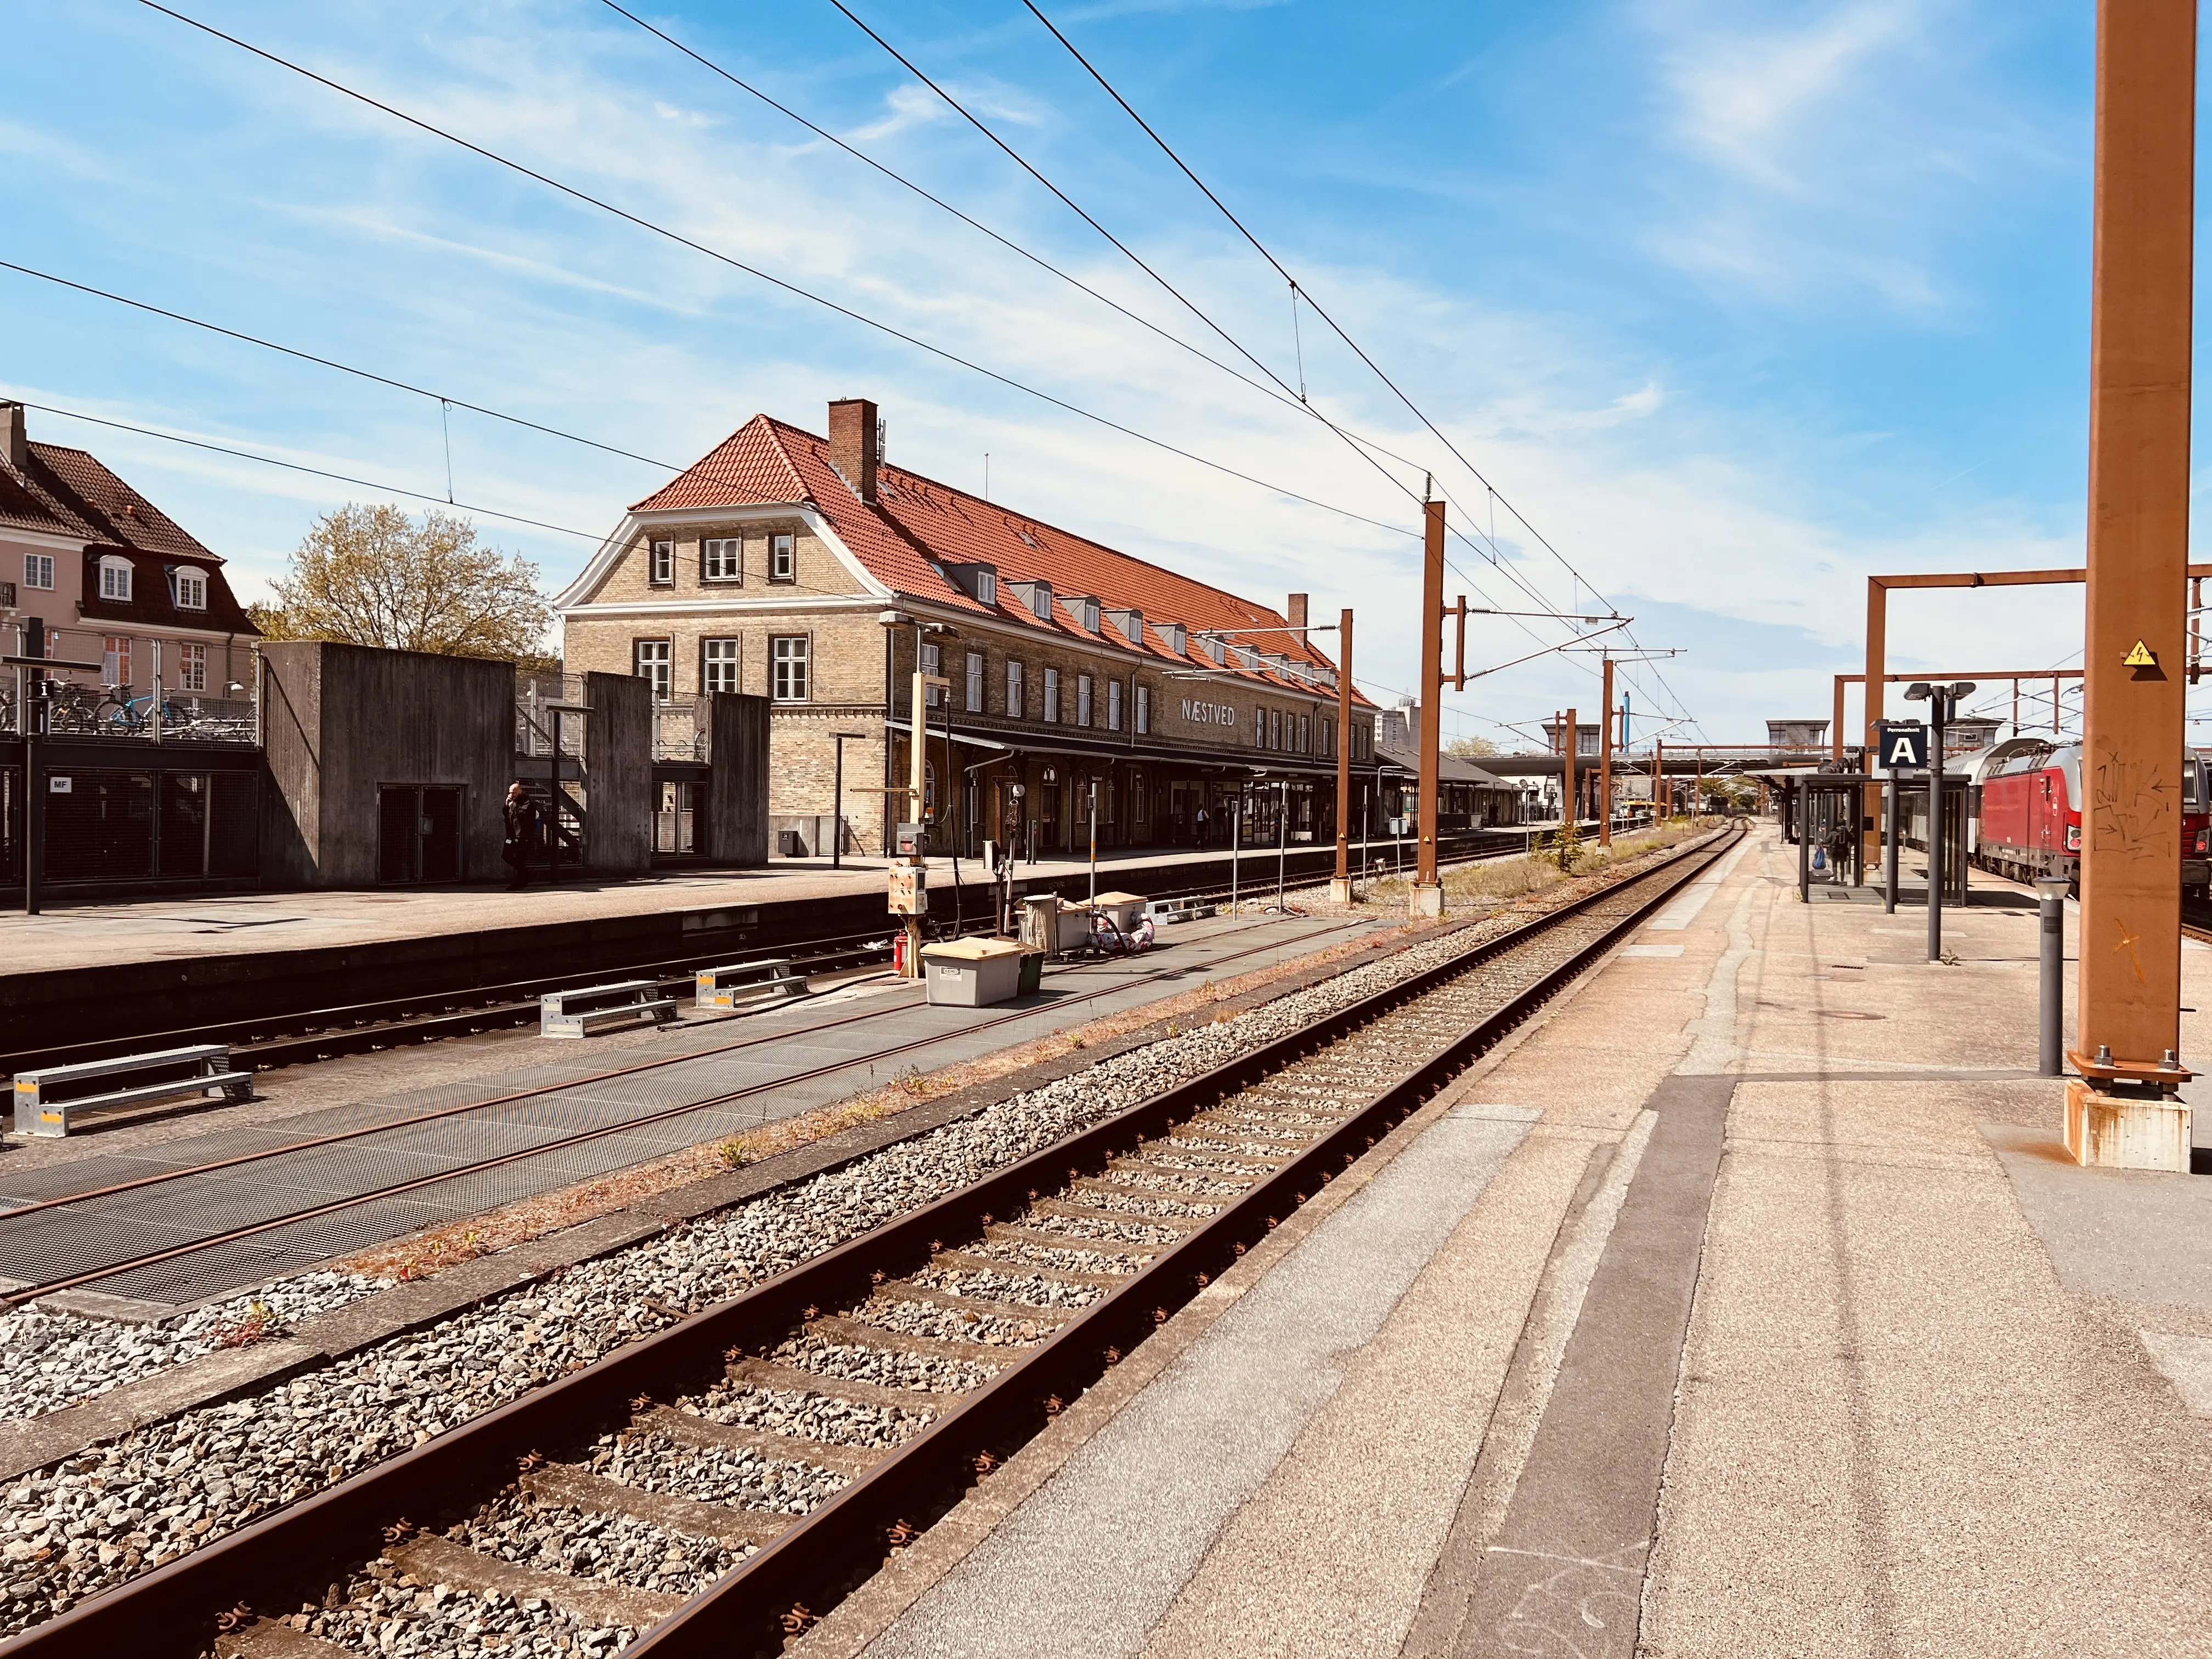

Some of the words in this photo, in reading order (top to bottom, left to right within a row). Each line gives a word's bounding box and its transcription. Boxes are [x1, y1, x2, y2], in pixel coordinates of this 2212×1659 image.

[41, 686, 47, 696] 1
[1182, 699, 1234, 726] NÆSTVED
[1889, 737, 1917, 763] A
